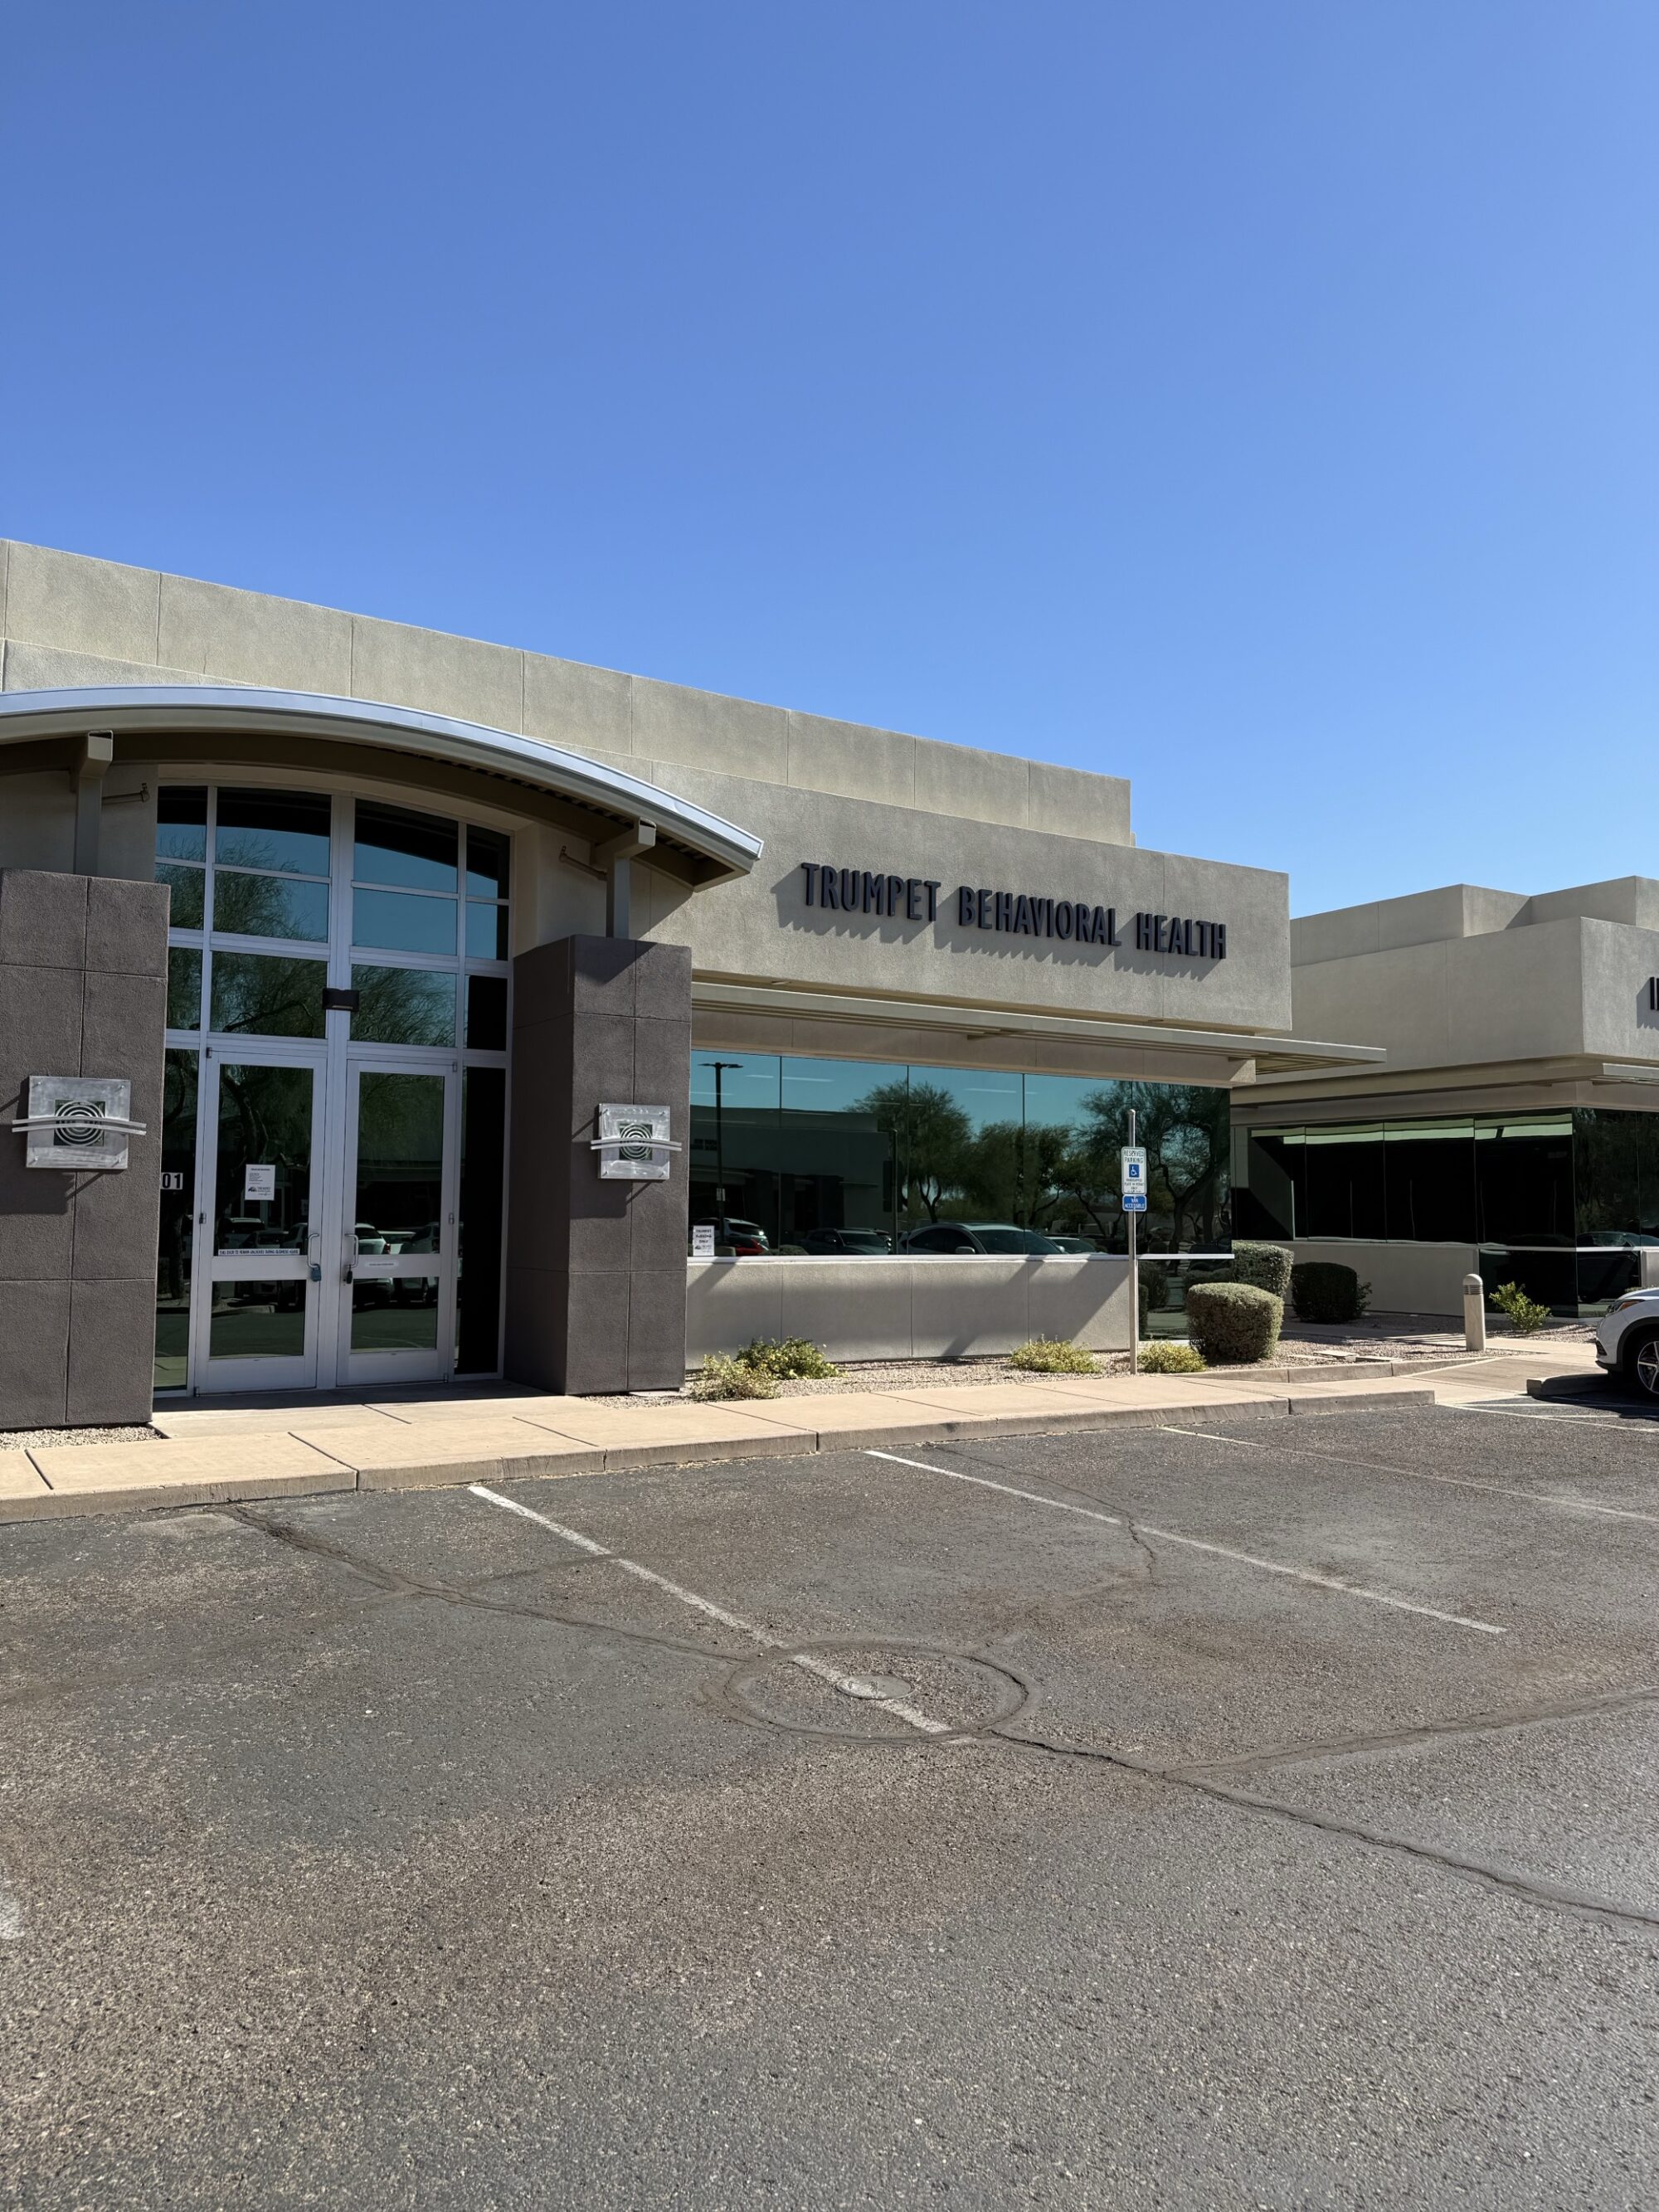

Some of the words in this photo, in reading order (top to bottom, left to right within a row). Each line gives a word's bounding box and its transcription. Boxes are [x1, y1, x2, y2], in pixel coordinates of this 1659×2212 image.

[801, 863, 941, 921] TRUMPET
[959, 886, 1121, 946] BEHAVIORAL
[1136, 912, 1226, 960] HEALTH
